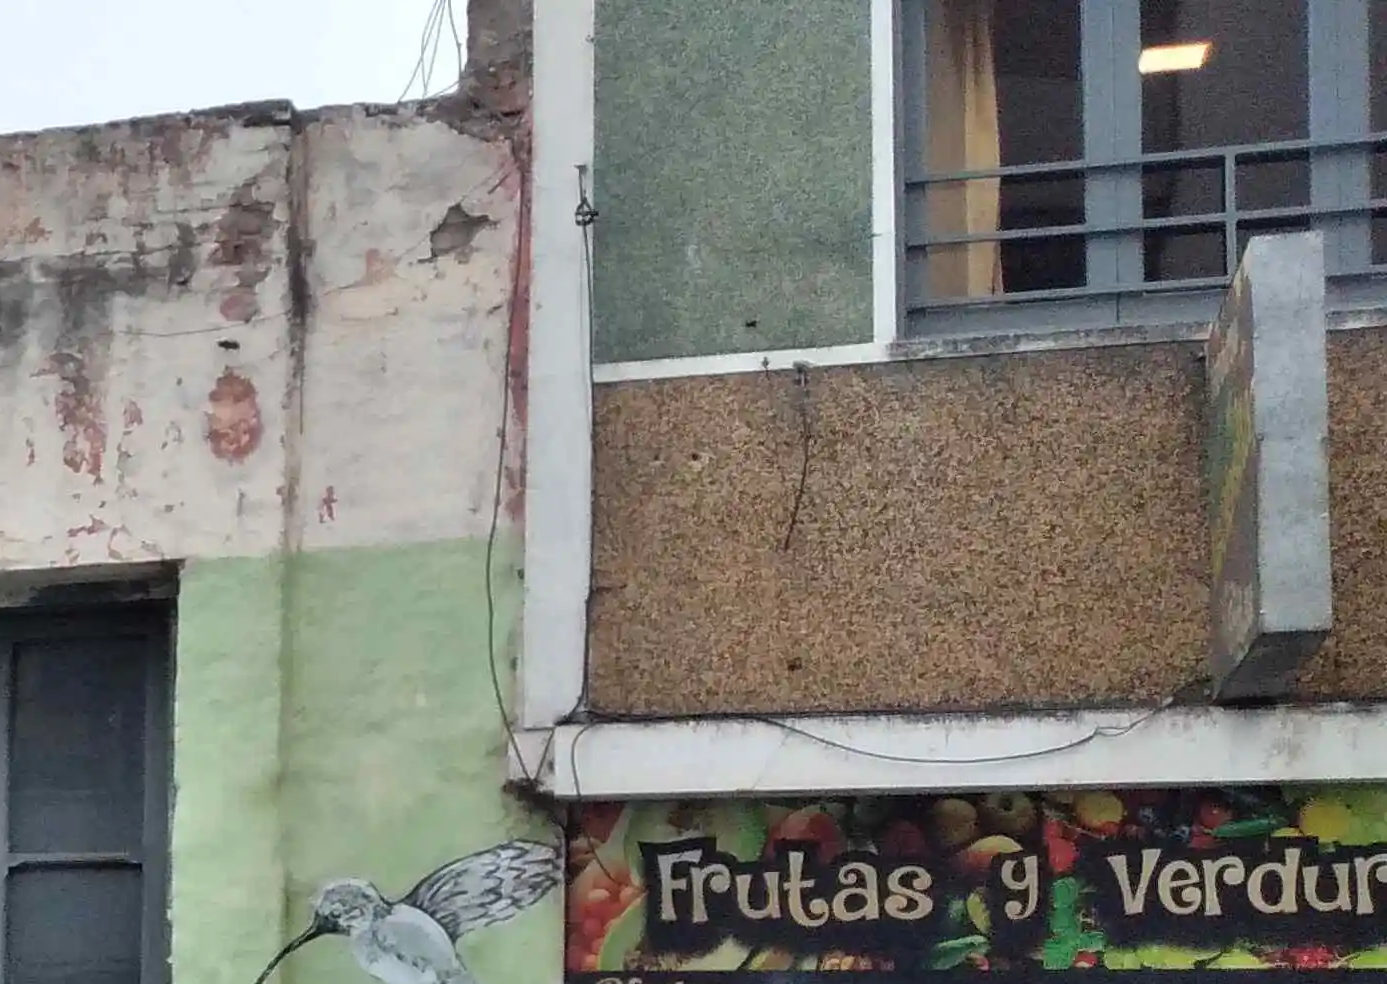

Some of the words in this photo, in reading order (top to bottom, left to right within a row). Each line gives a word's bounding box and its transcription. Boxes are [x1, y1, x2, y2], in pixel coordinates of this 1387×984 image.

[657, 850, 935, 928] Frutas
[999, 855, 1040, 920] y
[1107, 847, 1387, 915] Verdur
